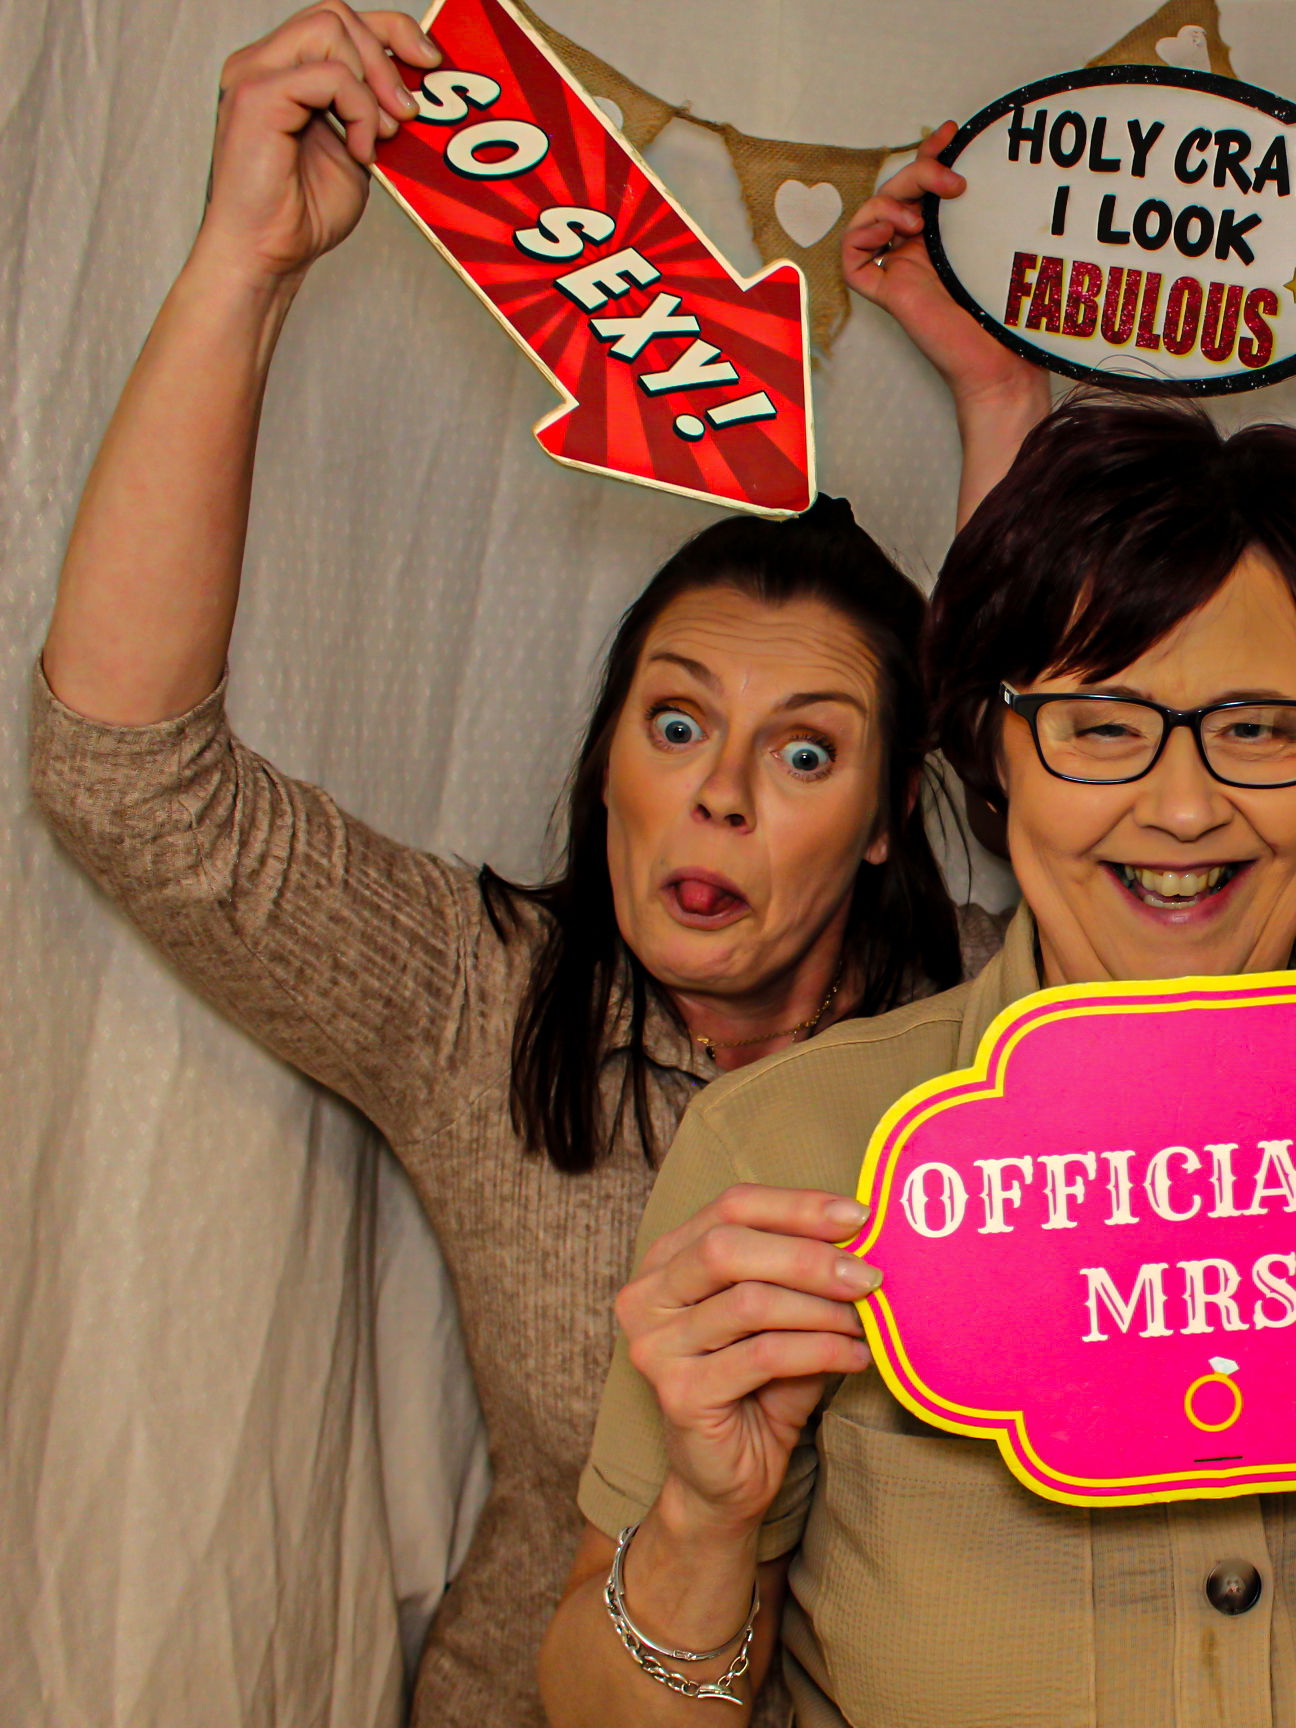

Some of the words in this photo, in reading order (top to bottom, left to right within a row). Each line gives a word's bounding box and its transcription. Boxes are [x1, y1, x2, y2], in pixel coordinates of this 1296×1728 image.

[413, 69, 550, 181] SO
[1007, 106, 1164, 178] HOLY
[1050, 185, 1071, 236] I
[1096, 193, 1262, 266] LOOK
[513, 206, 778, 442] SEXY!
[1003, 251, 1279, 369] FABULOUS
